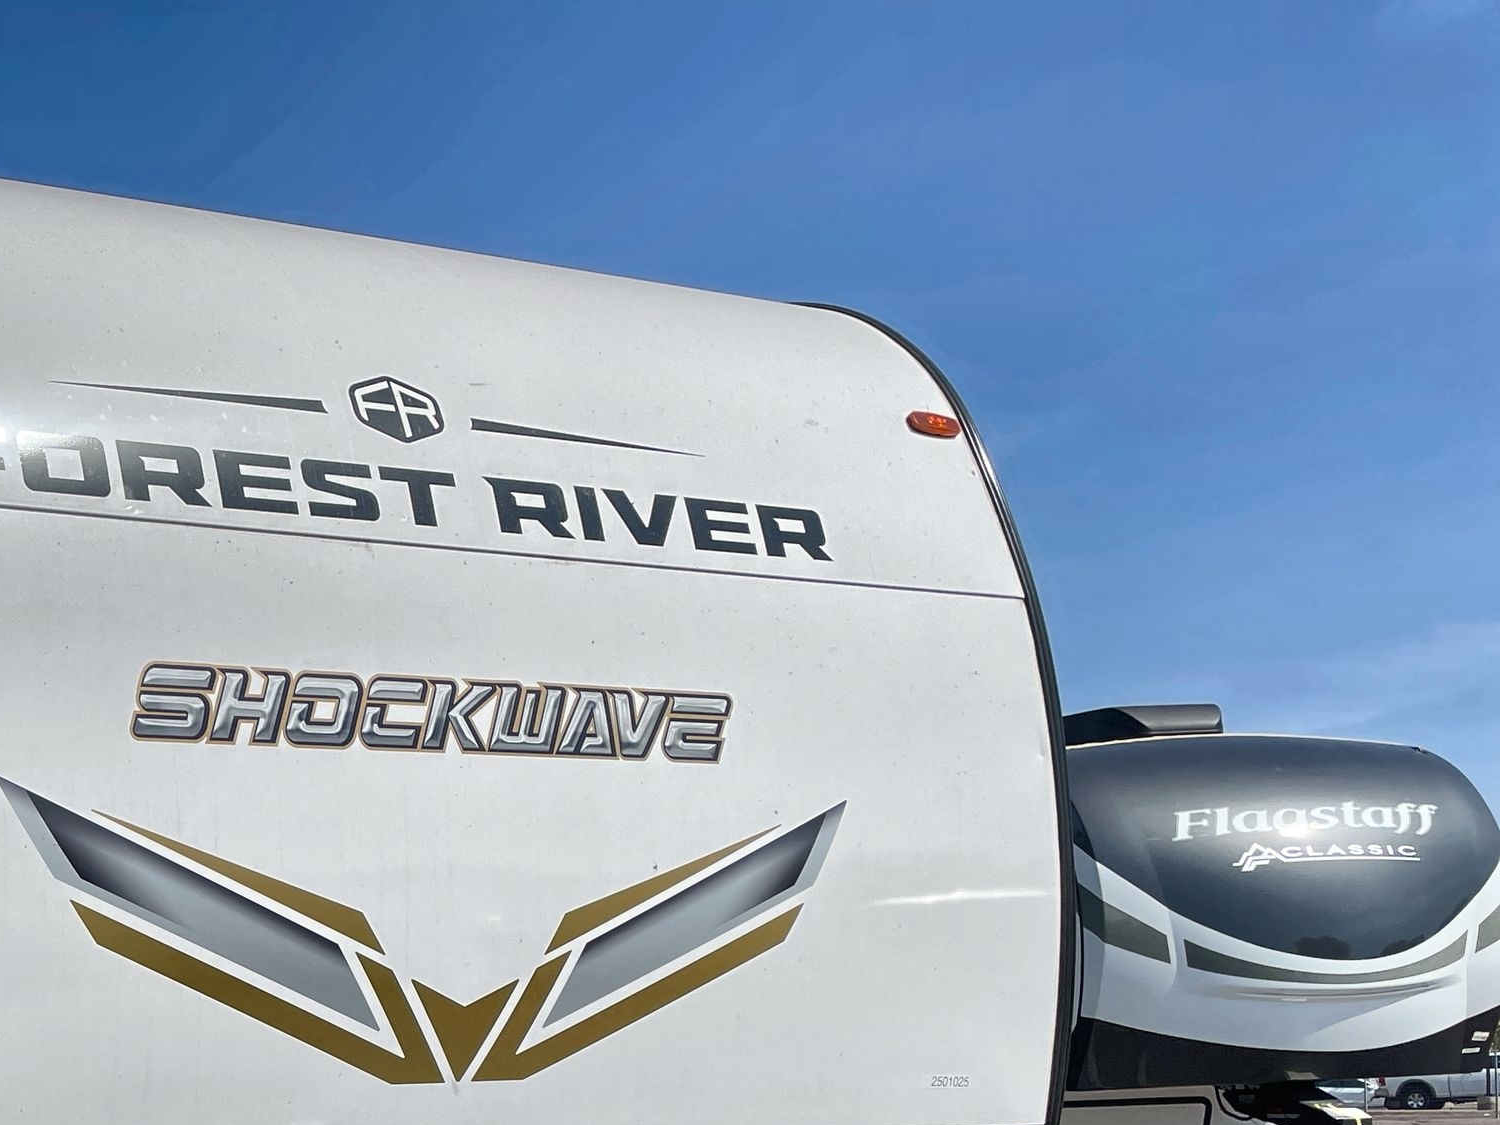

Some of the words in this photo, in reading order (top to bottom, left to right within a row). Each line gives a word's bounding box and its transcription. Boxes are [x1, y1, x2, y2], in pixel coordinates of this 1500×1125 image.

[481, 475, 834, 562] RIVER
[130, 660, 733, 764] SHOCKWAVE
[1172, 800, 1439, 842] Flagstaff
[1280, 843, 1418, 858] CLASSIC
[931, 1076, 970, 1088] 2501025
